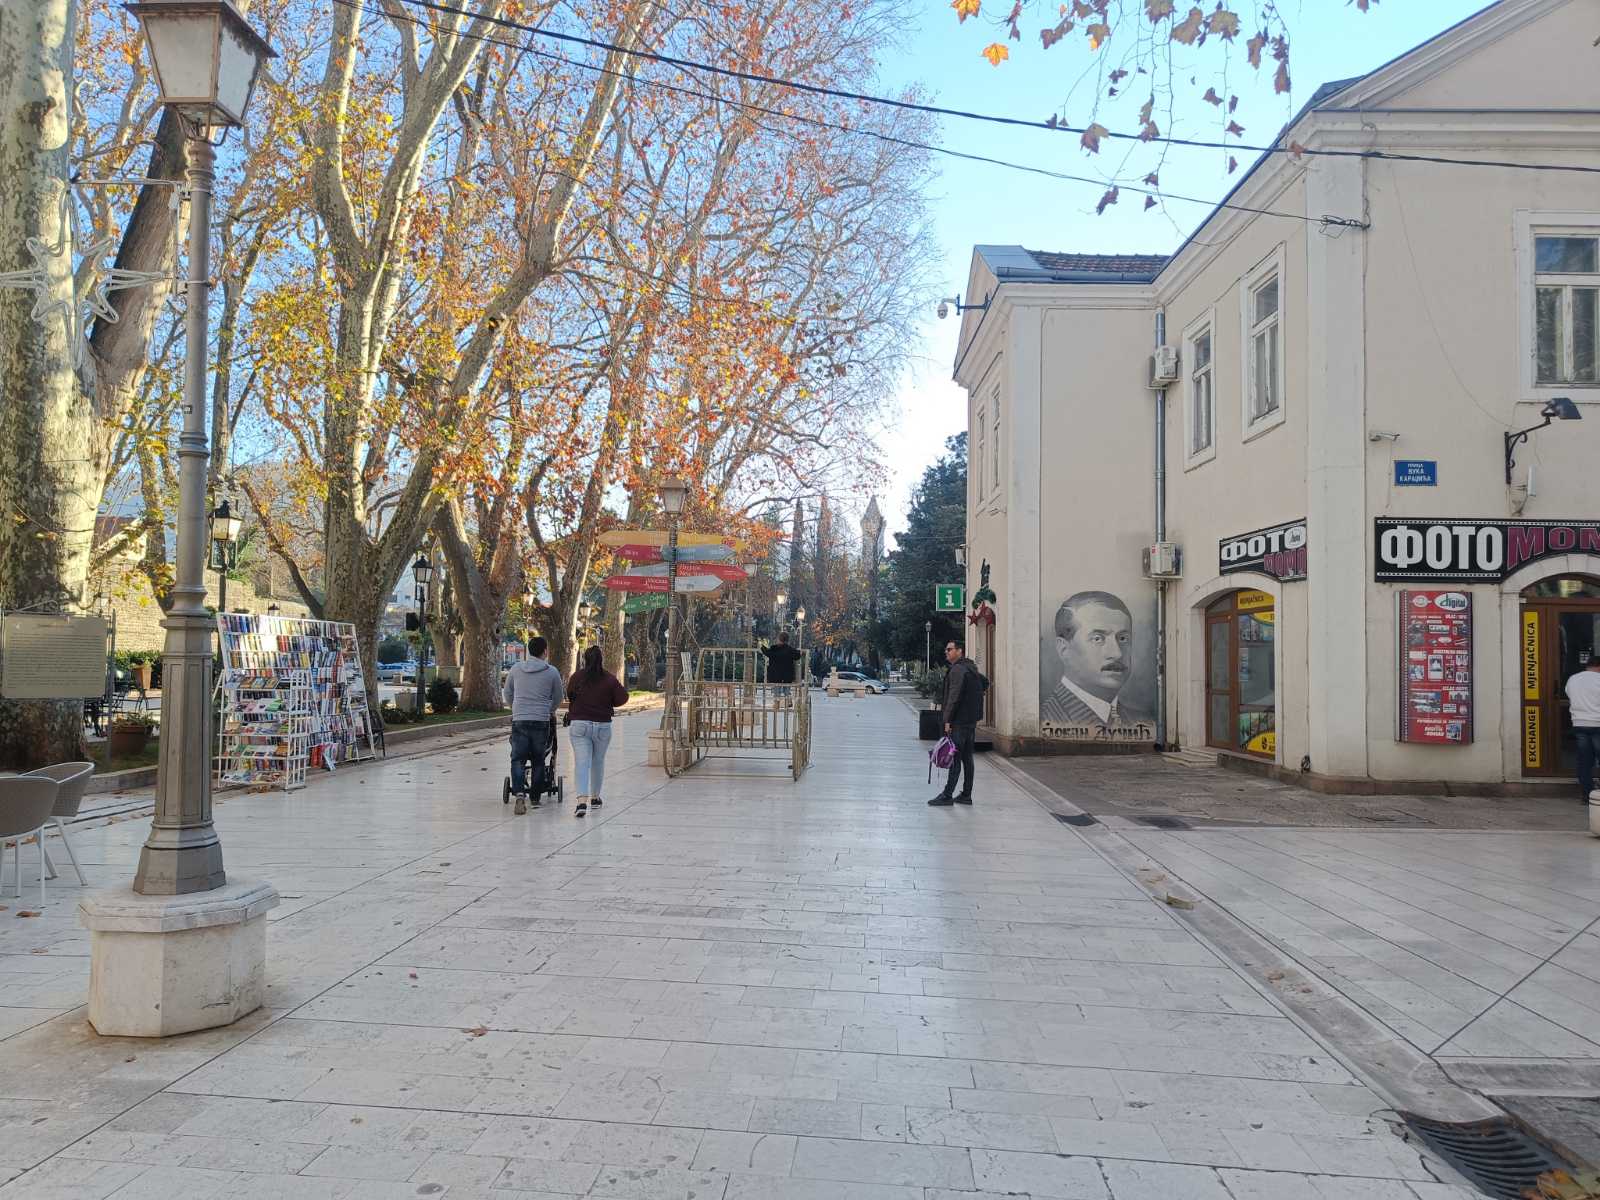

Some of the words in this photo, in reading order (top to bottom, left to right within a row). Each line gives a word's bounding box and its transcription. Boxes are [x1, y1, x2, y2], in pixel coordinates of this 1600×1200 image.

[1221, 526, 1306, 561] ФОТО
[1380, 525, 1503, 571] ФОТО
[1528, 709, 1537, 763] EXCHANGE
